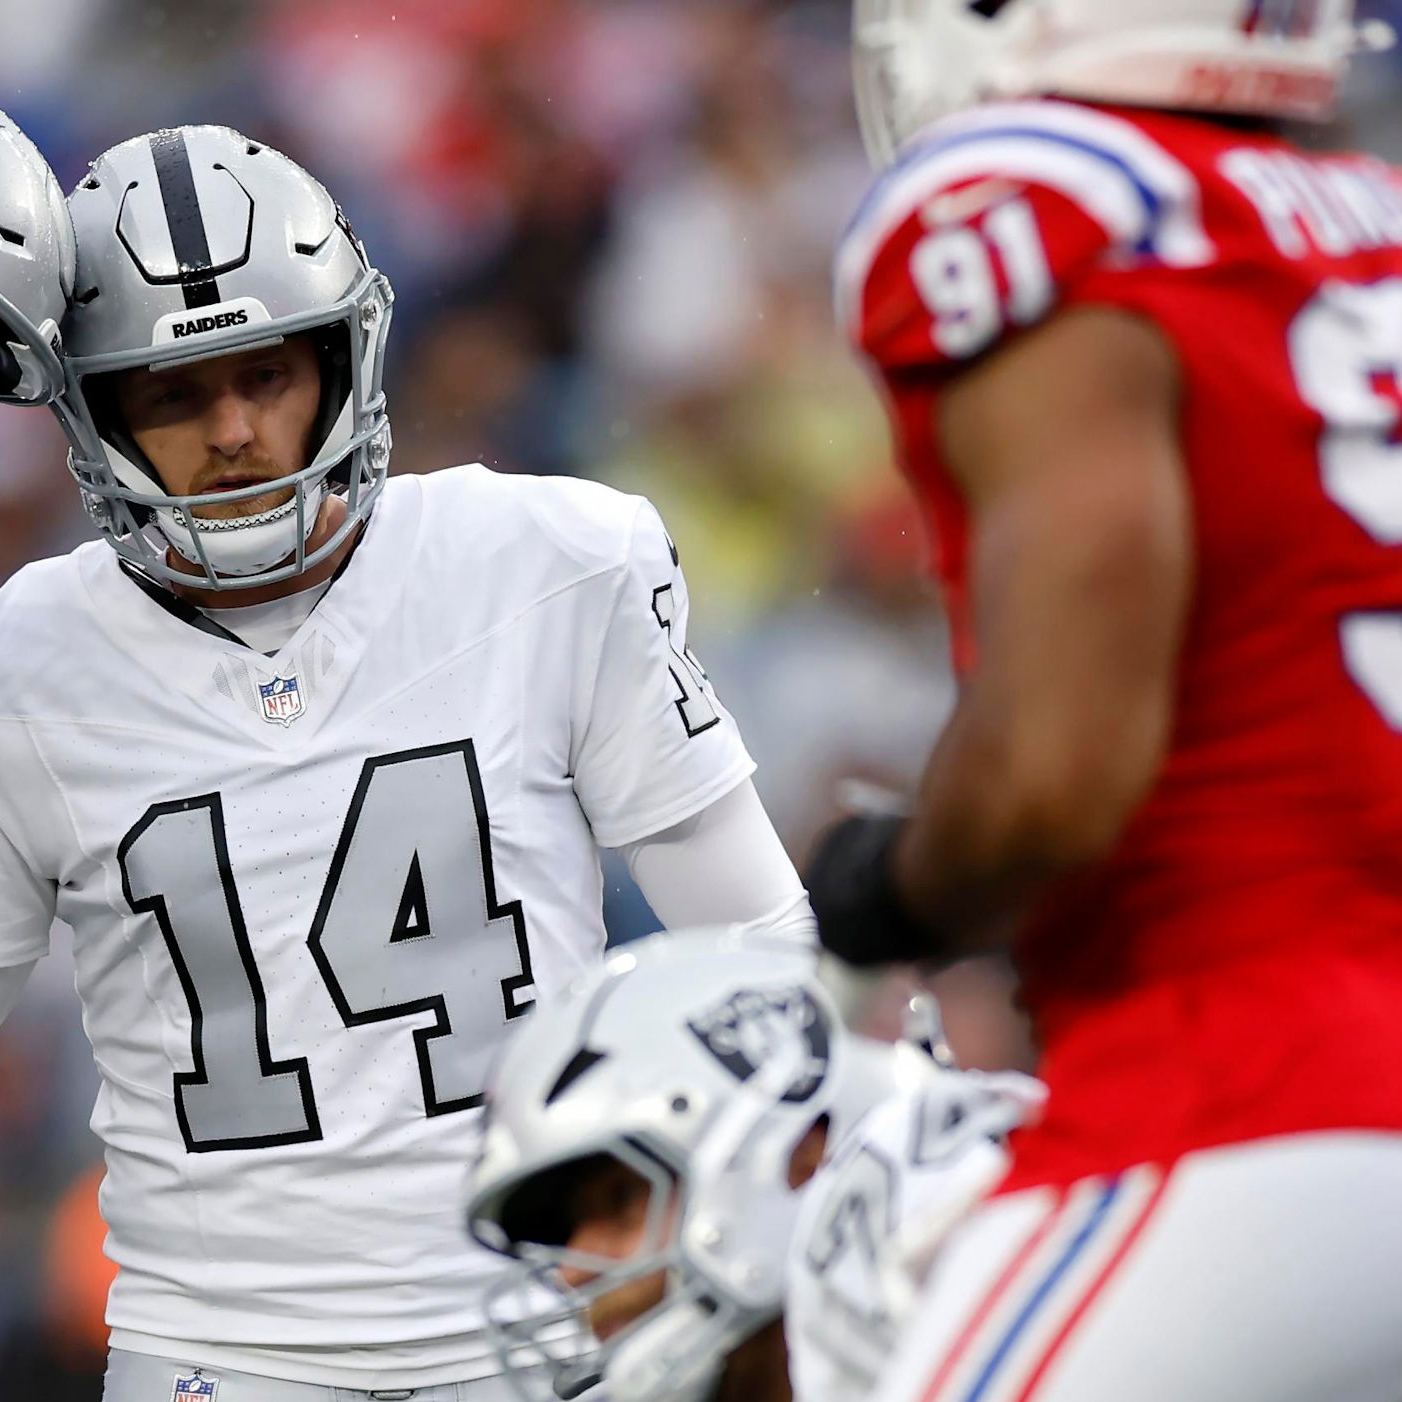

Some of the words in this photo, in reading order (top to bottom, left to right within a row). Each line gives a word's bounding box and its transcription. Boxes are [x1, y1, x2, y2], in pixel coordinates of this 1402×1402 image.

[172, 309, 248, 338] RAIDERS
[909, 198, 1054, 360] 91
[266, 694, 299, 716] NFL
[117, 739, 535, 1153] 14
